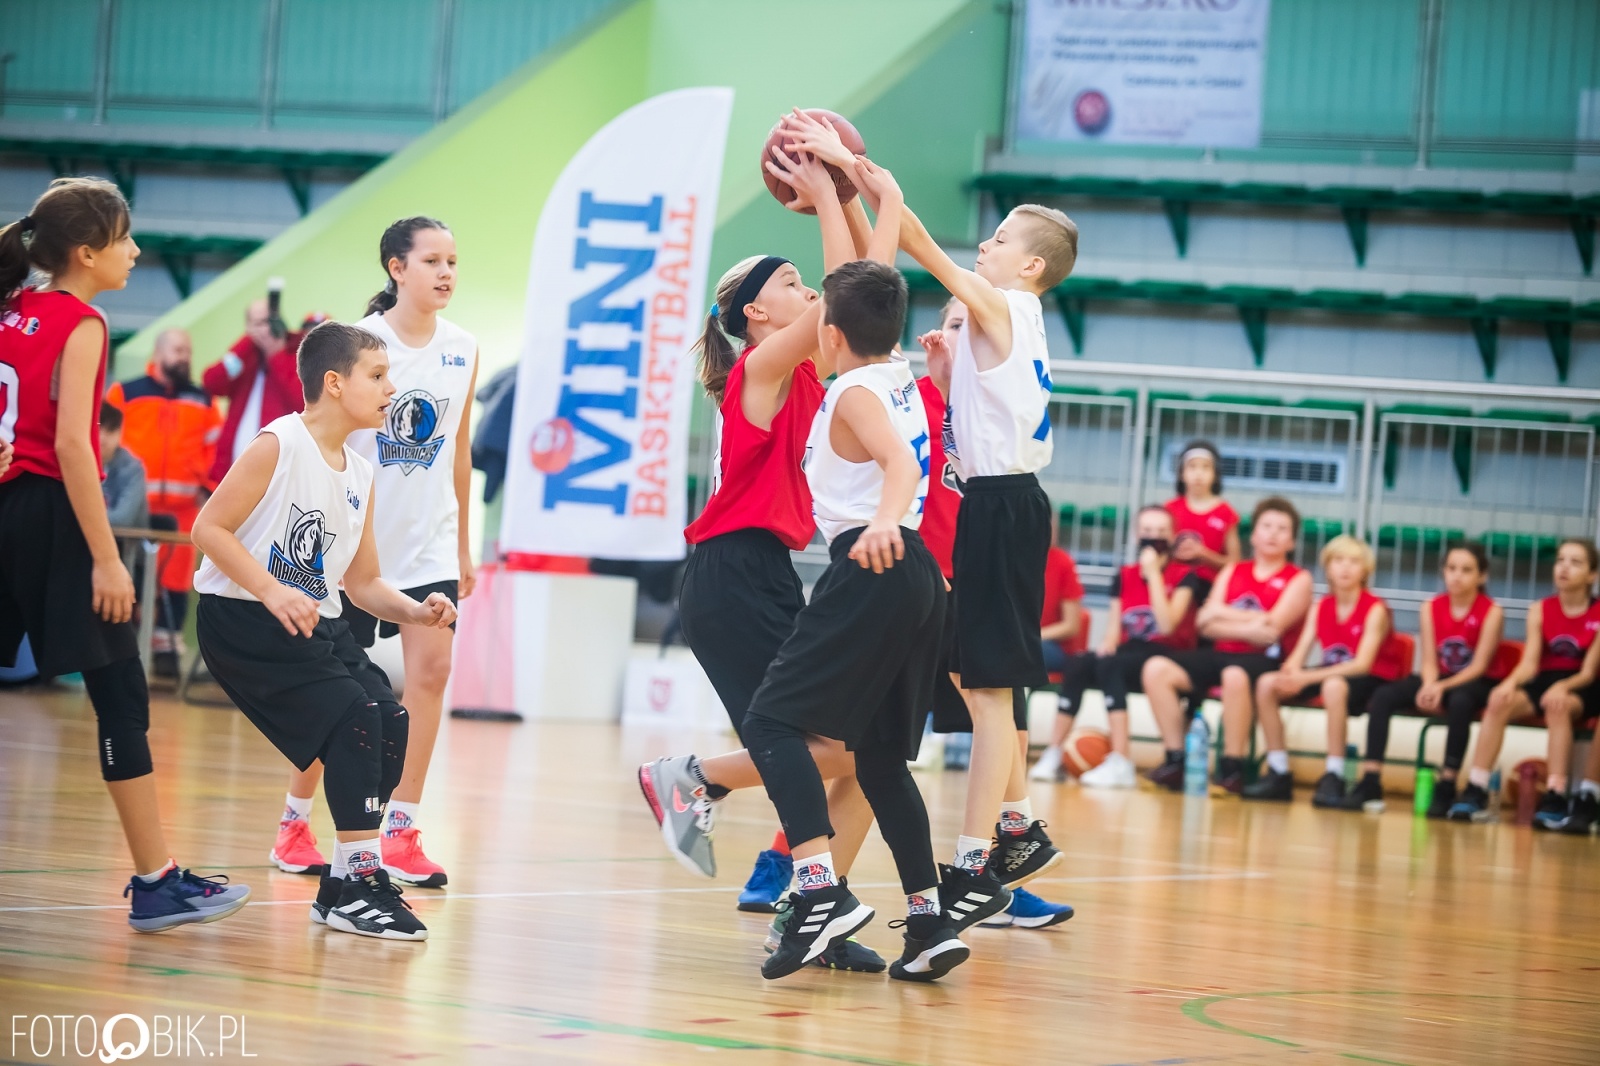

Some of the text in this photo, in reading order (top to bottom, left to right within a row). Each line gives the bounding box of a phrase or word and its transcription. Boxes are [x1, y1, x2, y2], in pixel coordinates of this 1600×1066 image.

[541, 190, 664, 516] MINI
[632, 195, 698, 518] BASKETBALL
[380, 440, 439, 462] MAVERICKS
[270, 551, 328, 597] MAVERICKS
